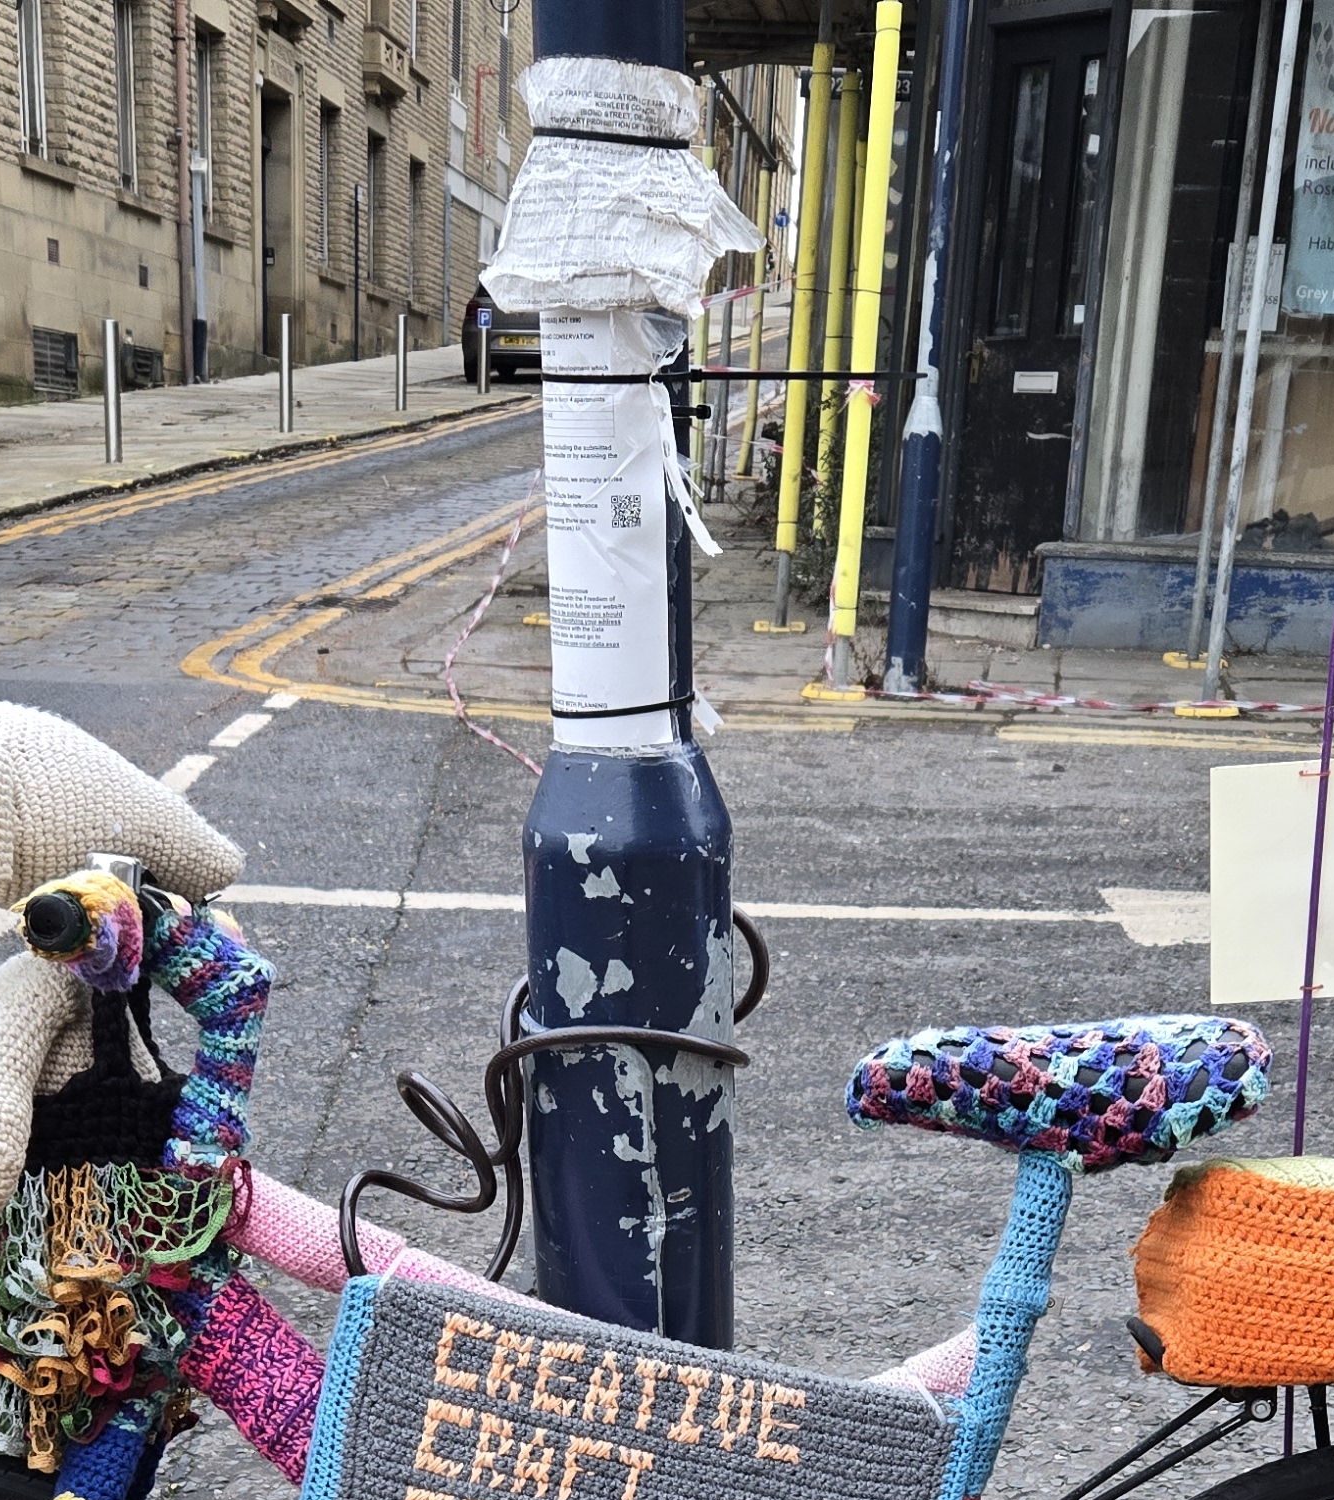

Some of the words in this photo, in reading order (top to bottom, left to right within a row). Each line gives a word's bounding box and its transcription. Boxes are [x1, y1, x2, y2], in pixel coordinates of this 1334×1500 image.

[594, 91, 638, 102] REGULATION
[1296, 285, 1329, 305] Grey
[480, 312, 490, 325] P
[579, 476, 601, 484] strongly
[577, 701, 608, 709] PLANNING
[433, 1311, 807, 1465] CREATIVE
